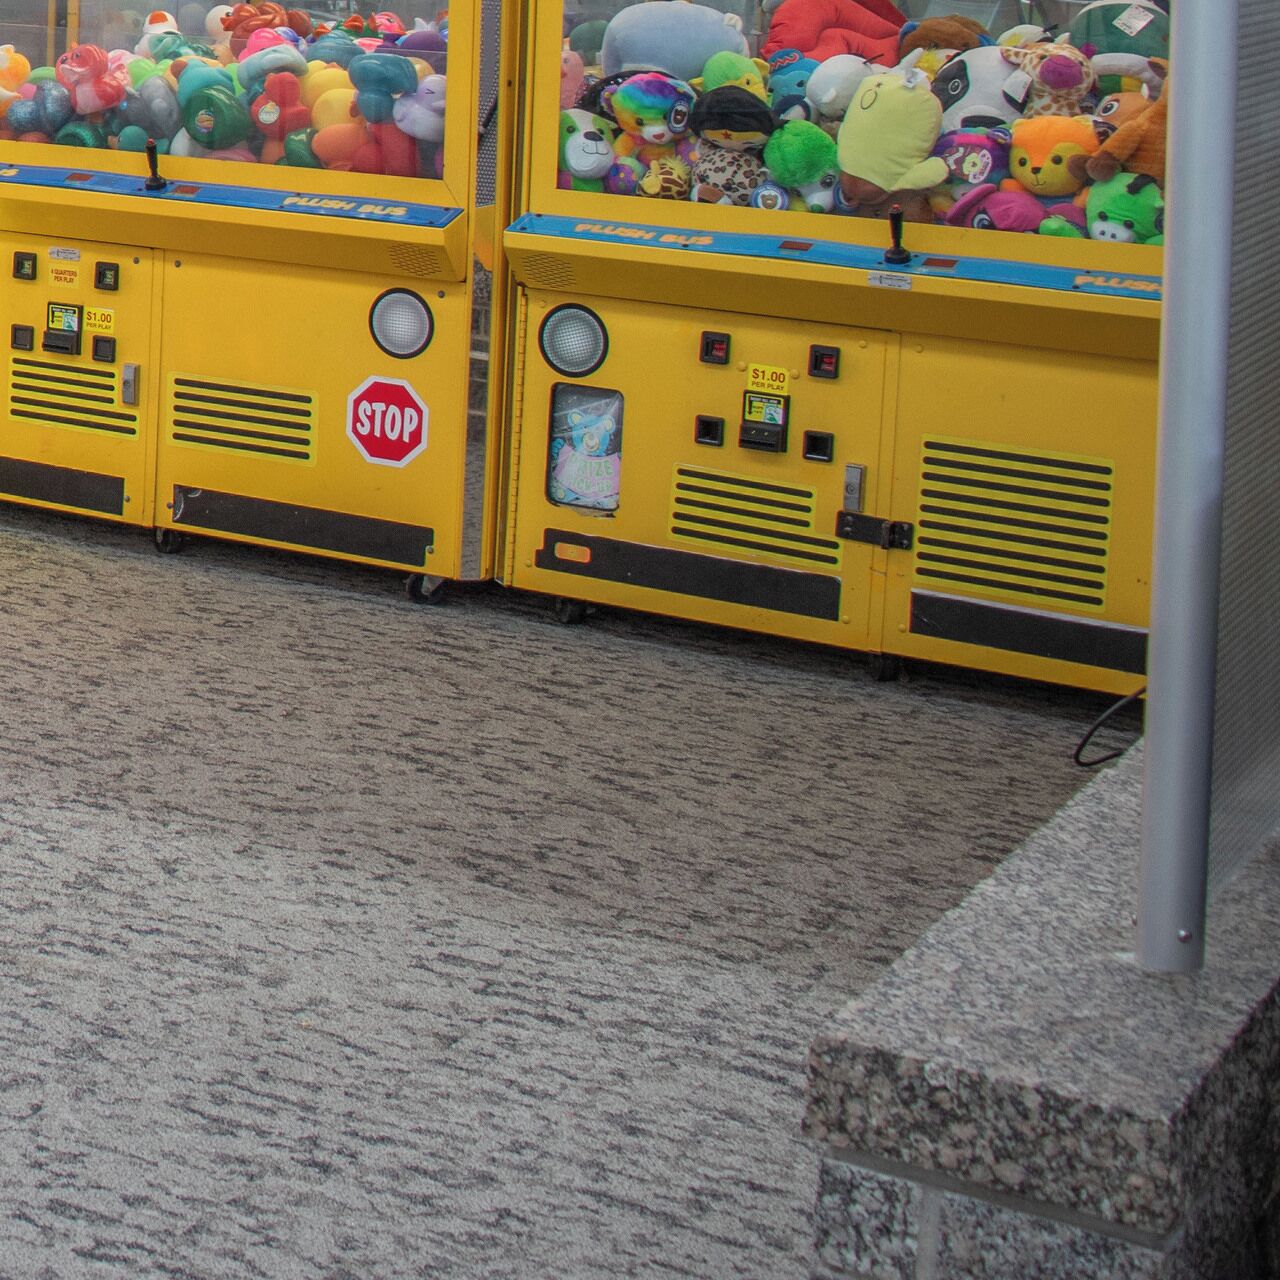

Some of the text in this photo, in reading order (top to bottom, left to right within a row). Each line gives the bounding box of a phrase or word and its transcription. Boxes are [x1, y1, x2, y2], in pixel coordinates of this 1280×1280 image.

[283, 196, 408, 216] PLUSH BUS
[574, 223, 714, 245] PLUSH BUS
[54, 269, 78, 278] QUARTERS
[64, 276, 74, 284] PLAY
[86, 312, 112, 324] $1.00
[752, 368, 786, 383] $1.00
[752, 380, 784, 391] PER PLAY
[356, 401, 419, 444] STOP
